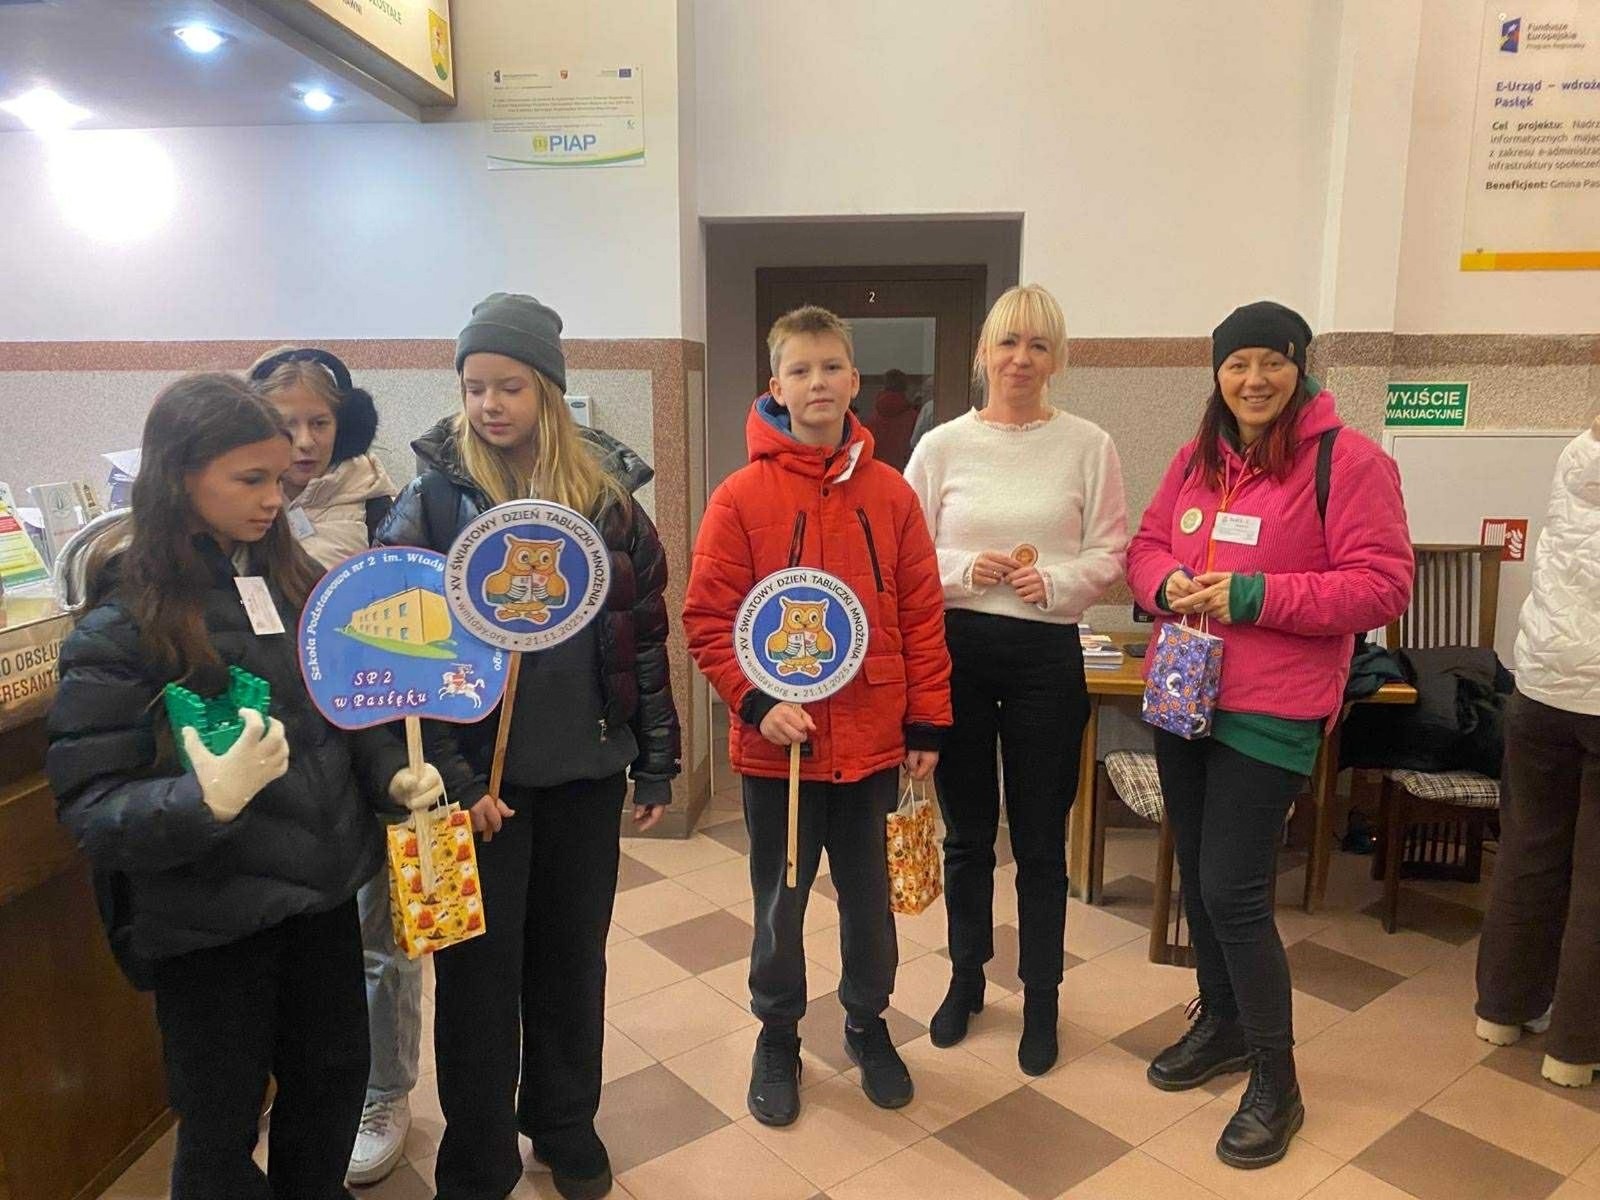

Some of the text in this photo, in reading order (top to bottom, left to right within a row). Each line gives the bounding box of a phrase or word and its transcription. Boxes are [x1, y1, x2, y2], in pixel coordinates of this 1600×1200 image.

[1496, 80, 1543, 93] E-Urząd
[1495, 96, 1534, 108] Pasłęk
[1492, 121, 1509, 131] Cel
[1517, 121, 1563, 132] projektu:
[550, 134, 597, 152] PIAP
[1490, 134, 1569, 144] informatycznych
[1488, 160, 1553, 171] infrastruktury
[1485, 180, 1548, 191] Beneficjent:
[1549, 180, 1582, 189] Gmina
[869, 291, 876, 303] 2
[1386, 387, 1461, 406] WYJŚCIE
[368, 556, 376, 566] 2
[383, 553, 402, 563] im.
[451, 507, 605, 607] XV ŚWIATOWY DZIEŃ TABLICZKI MNOŻENIA
[351, 561, 365, 573] nr
[306, 570, 350, 635] Podstawowa
[740, 572, 866, 659] XV ŚWIATOWY DZIEŃ TABLICZKI MNOŻENIA
[525, 614, 584, 646] 21.11.2025
[15, 641, 63, 672] OBSŁU
[306, 638, 322, 681] Szkoła
[0, 668, 60, 704] RESANT
[354, 671, 393, 686] SP 2
[803, 668, 850, 697] 21.11.2025
[334, 690, 427, 708] w Pasłęku
